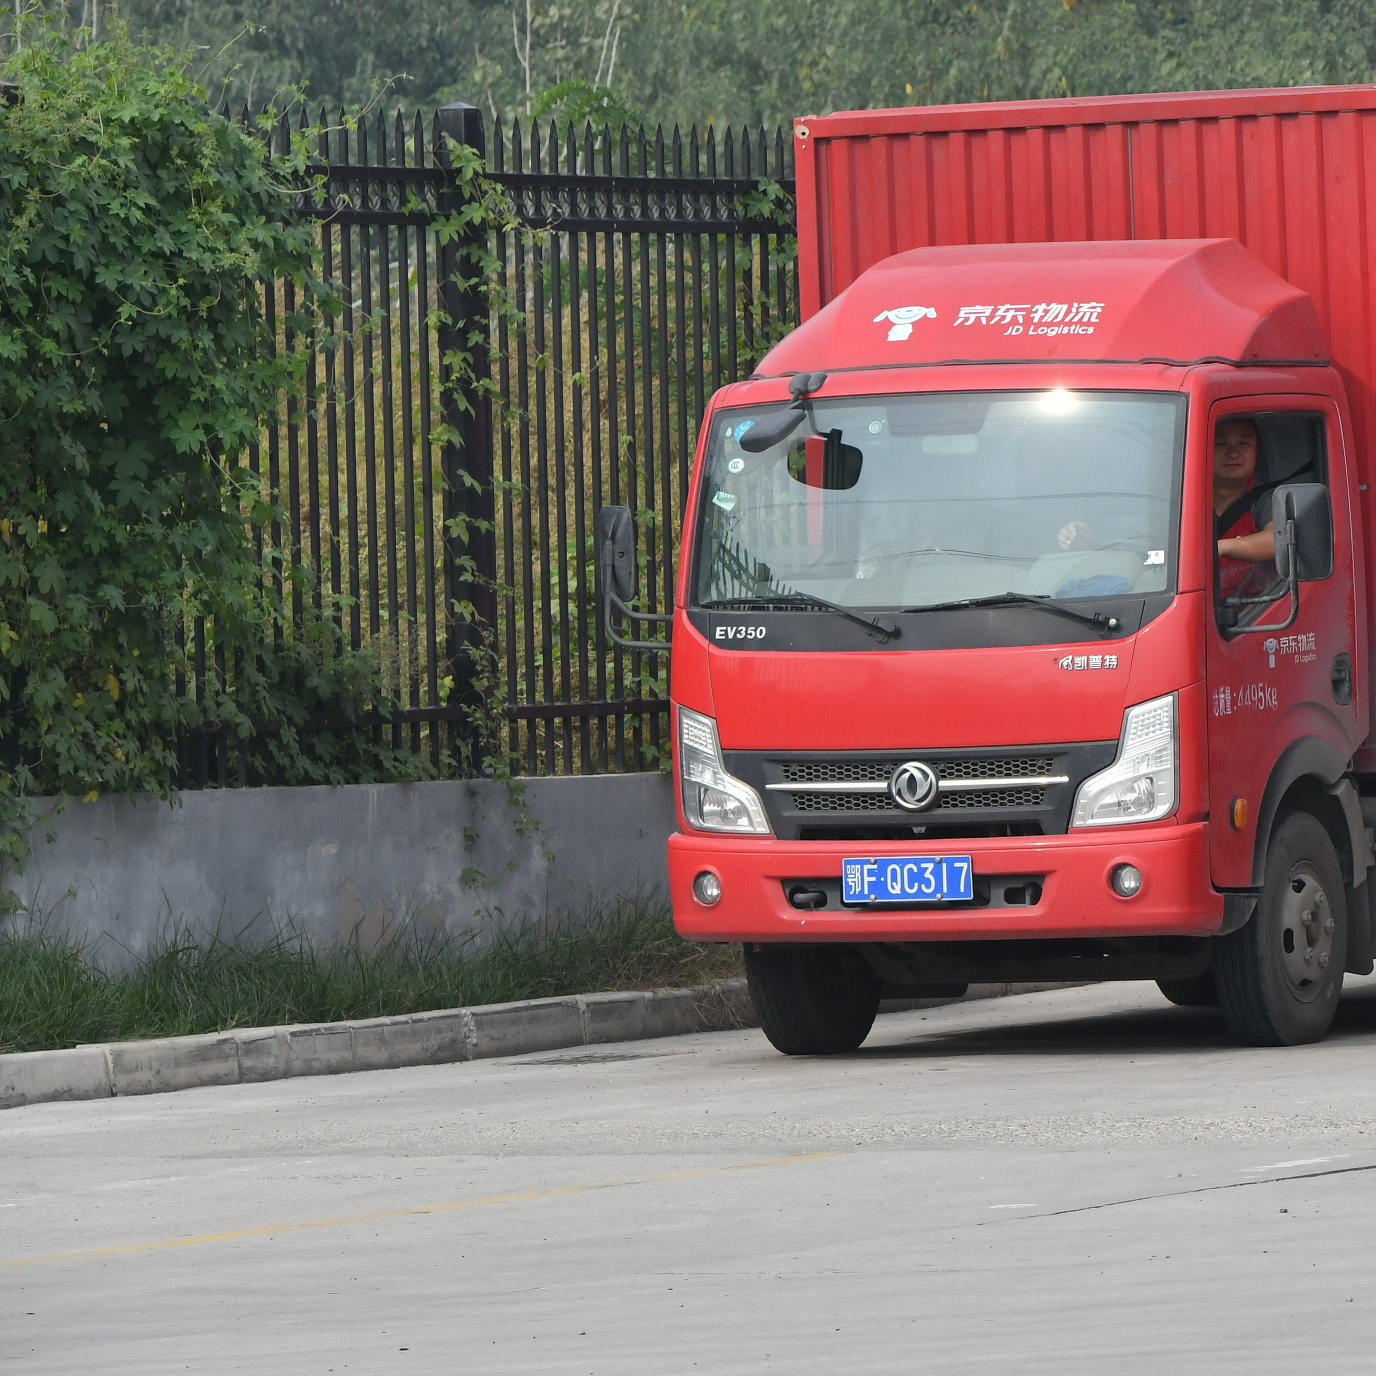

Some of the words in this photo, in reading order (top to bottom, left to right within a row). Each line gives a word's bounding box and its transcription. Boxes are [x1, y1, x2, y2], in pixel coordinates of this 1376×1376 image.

[952, 301, 1105, 327] 京东物流
[1003, 325, 1023, 336] JD
[1028, 325, 1095, 337] Logistics
[715, 626, 766, 640] EV350
[1280, 632, 1316, 655] 京东物流
[1073, 654, 1119, 671] 凯普特
